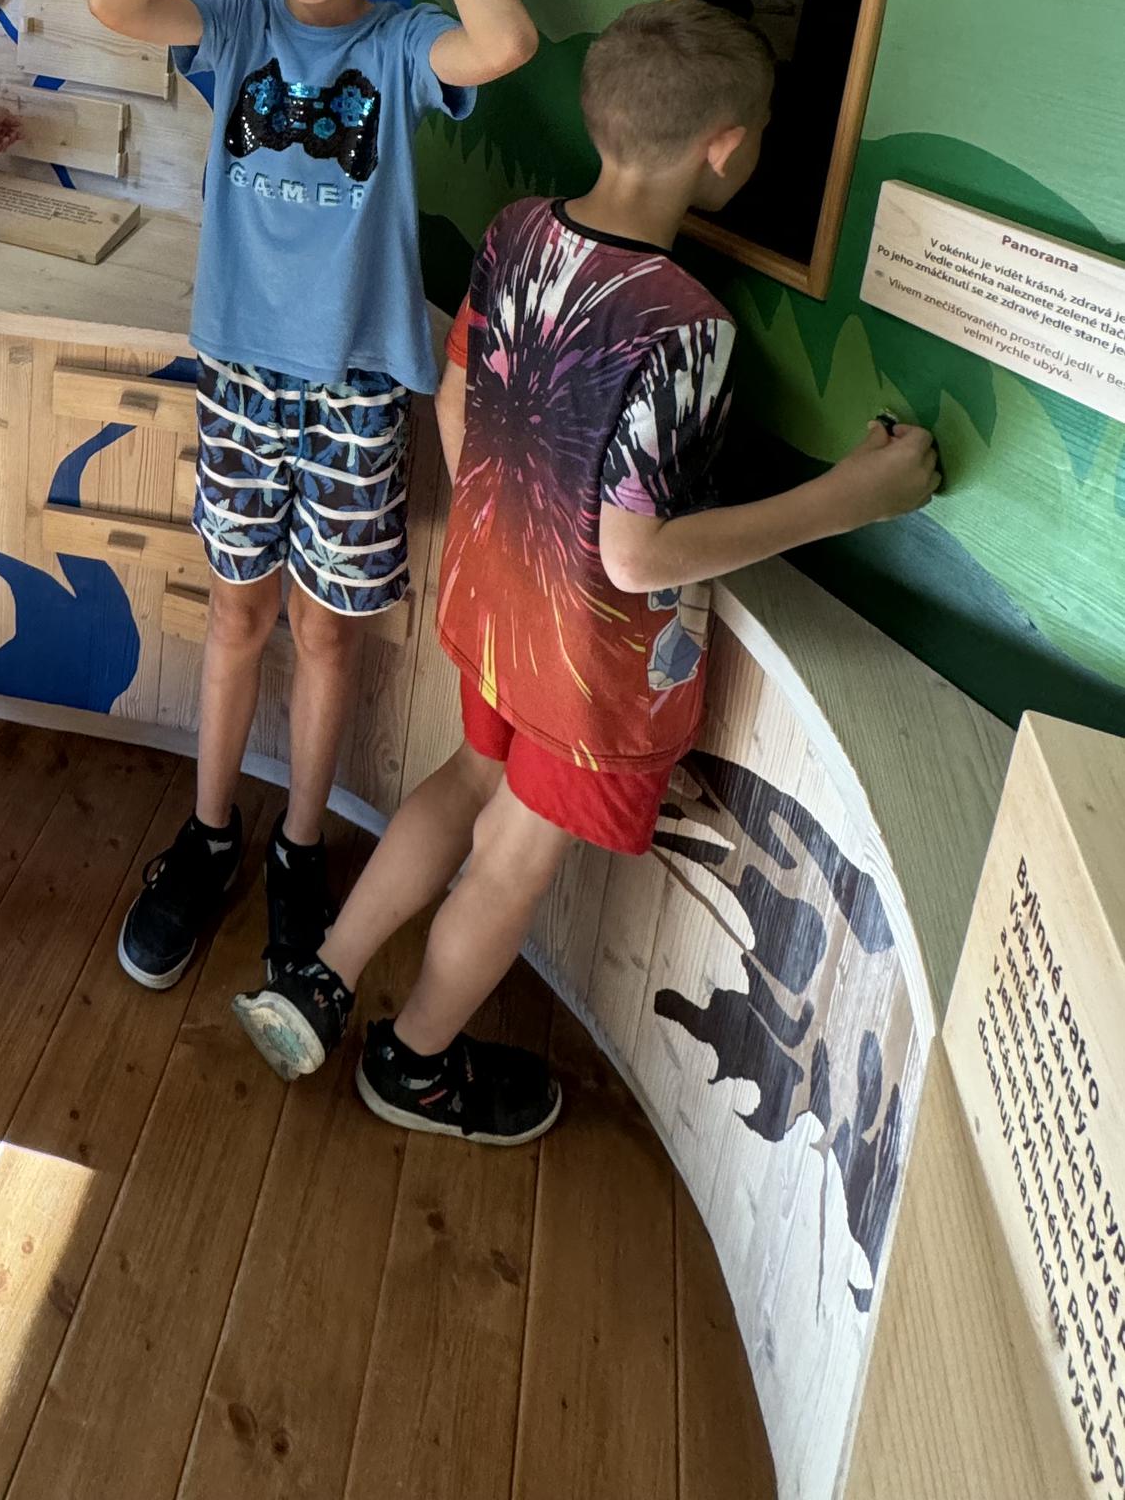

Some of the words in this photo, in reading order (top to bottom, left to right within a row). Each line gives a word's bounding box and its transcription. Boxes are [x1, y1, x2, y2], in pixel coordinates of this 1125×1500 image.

[877, 244, 890, 257] Po
[889, 250, 914, 267] jeho
[971, 286, 984, 297] se
[984, 291, 999, 303] ze
[1000, 298, 1040, 320] zdravé
[1039, 313, 1072, 334] jedle
[1074, 328, 1110, 349] stane
[924, 249, 953, 269] Vedle
[954, 264, 995, 286] okénka
[996, 281, 1054, 310] naleznete
[1055, 305, 1098, 329] zelené
[930, 237, 939, 248] V
[939, 244, 979, 265] okénku
[979, 258, 992, 270] je
[994, 265, 1024, 283] vidět
[1025, 275, 1067, 302] krásná,
[1069, 295, 1112, 318] zdravá
[1001, 234, 1079, 273] Panorama
[888, 276, 922, 299] Vlivem
[1096, 369, 1105, 379] v
[963, 326, 993, 345] velmi
[995, 340, 1031, 362] rychle
[1032, 358, 1072, 382] ubývá.
[993, 955, 1001, 976] v
[1016, 855, 1063, 995] Bylinné
[1058, 993, 1100, 1110] patro
[996, 973, 1053, 1164] jehličnatých
[1009, 889, 1039, 991] Výskyt
[1035, 983, 1049, 1022] je
[1047, 1021, 1088, 1136] závislý
[1085, 1139, 1102, 1193] na
[1000, 926, 1008, 948] a
[1053, 1096, 1086, 1209] lesích
[1086, 1204, 1120, 1316] bývá
[1018, 1101, 1069, 1287] bylinného
[1067, 1291, 1103, 1410] patra
[1052, 1159, 1086, 1278] lesích
[1086, 1282, 1117, 1382] dost
[1067, 1354, 1105, 1484] výšky
